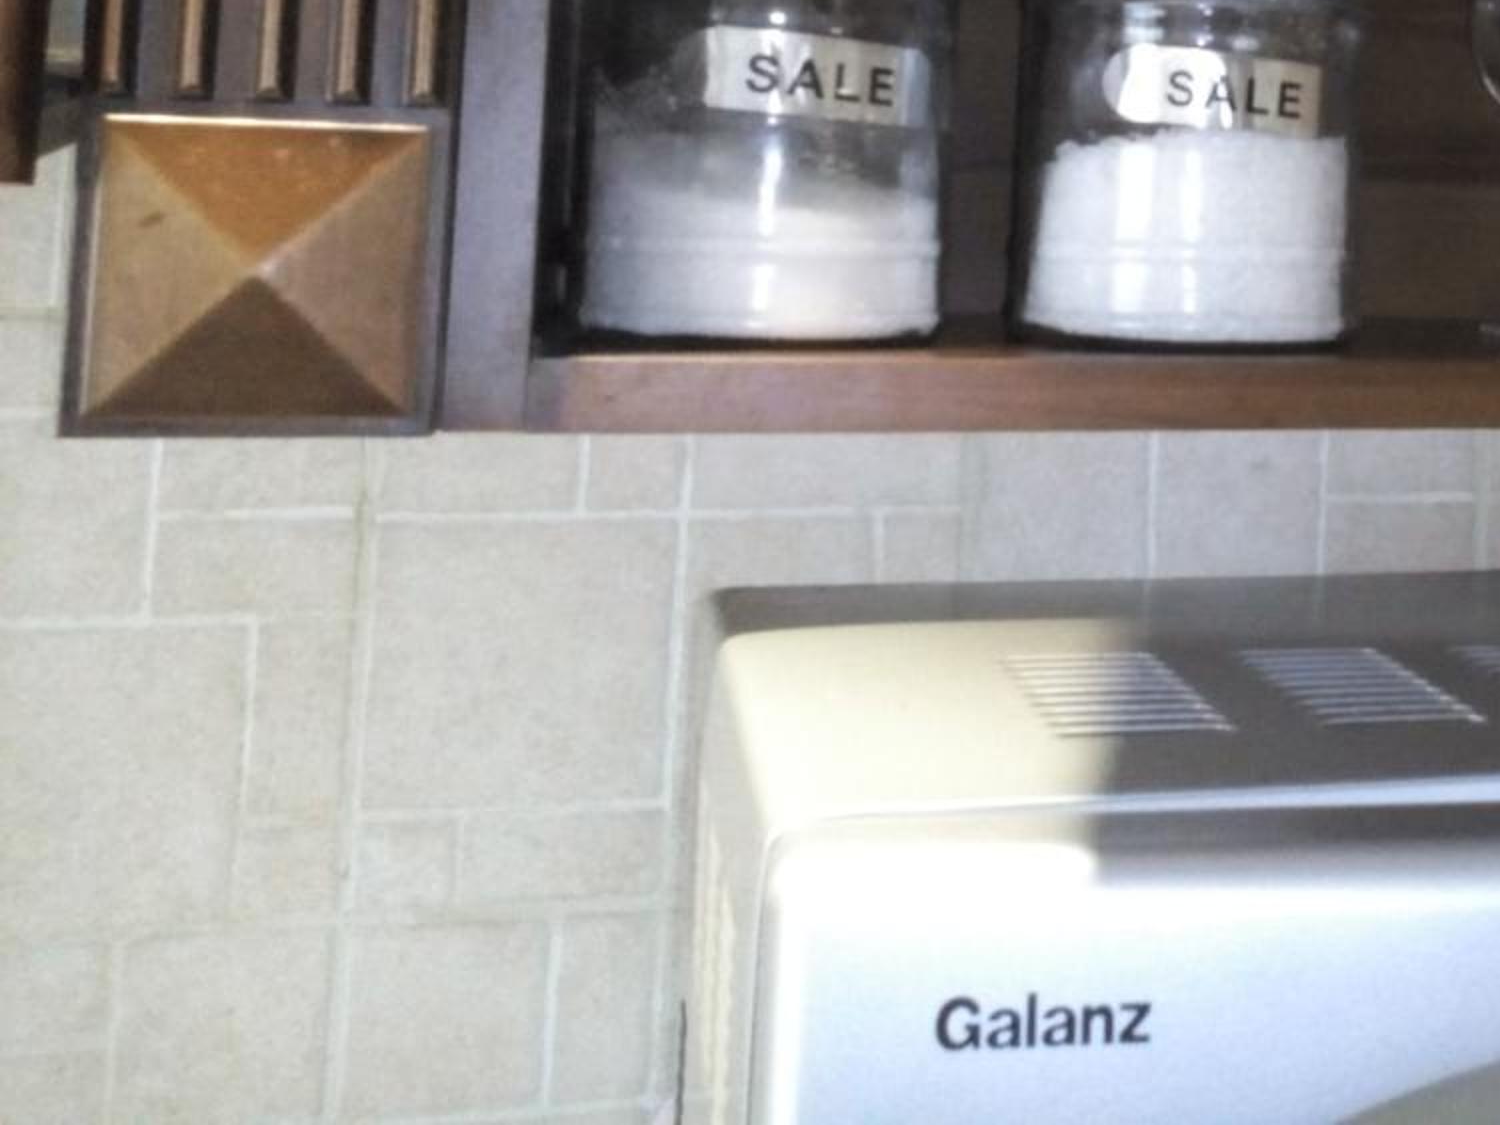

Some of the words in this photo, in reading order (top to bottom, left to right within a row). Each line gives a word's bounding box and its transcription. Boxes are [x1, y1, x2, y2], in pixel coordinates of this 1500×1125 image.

[745, 54, 895, 107] SALE
[1165, 70, 1303, 119] SALE
[935, 991, 1153, 1052] Galanz
